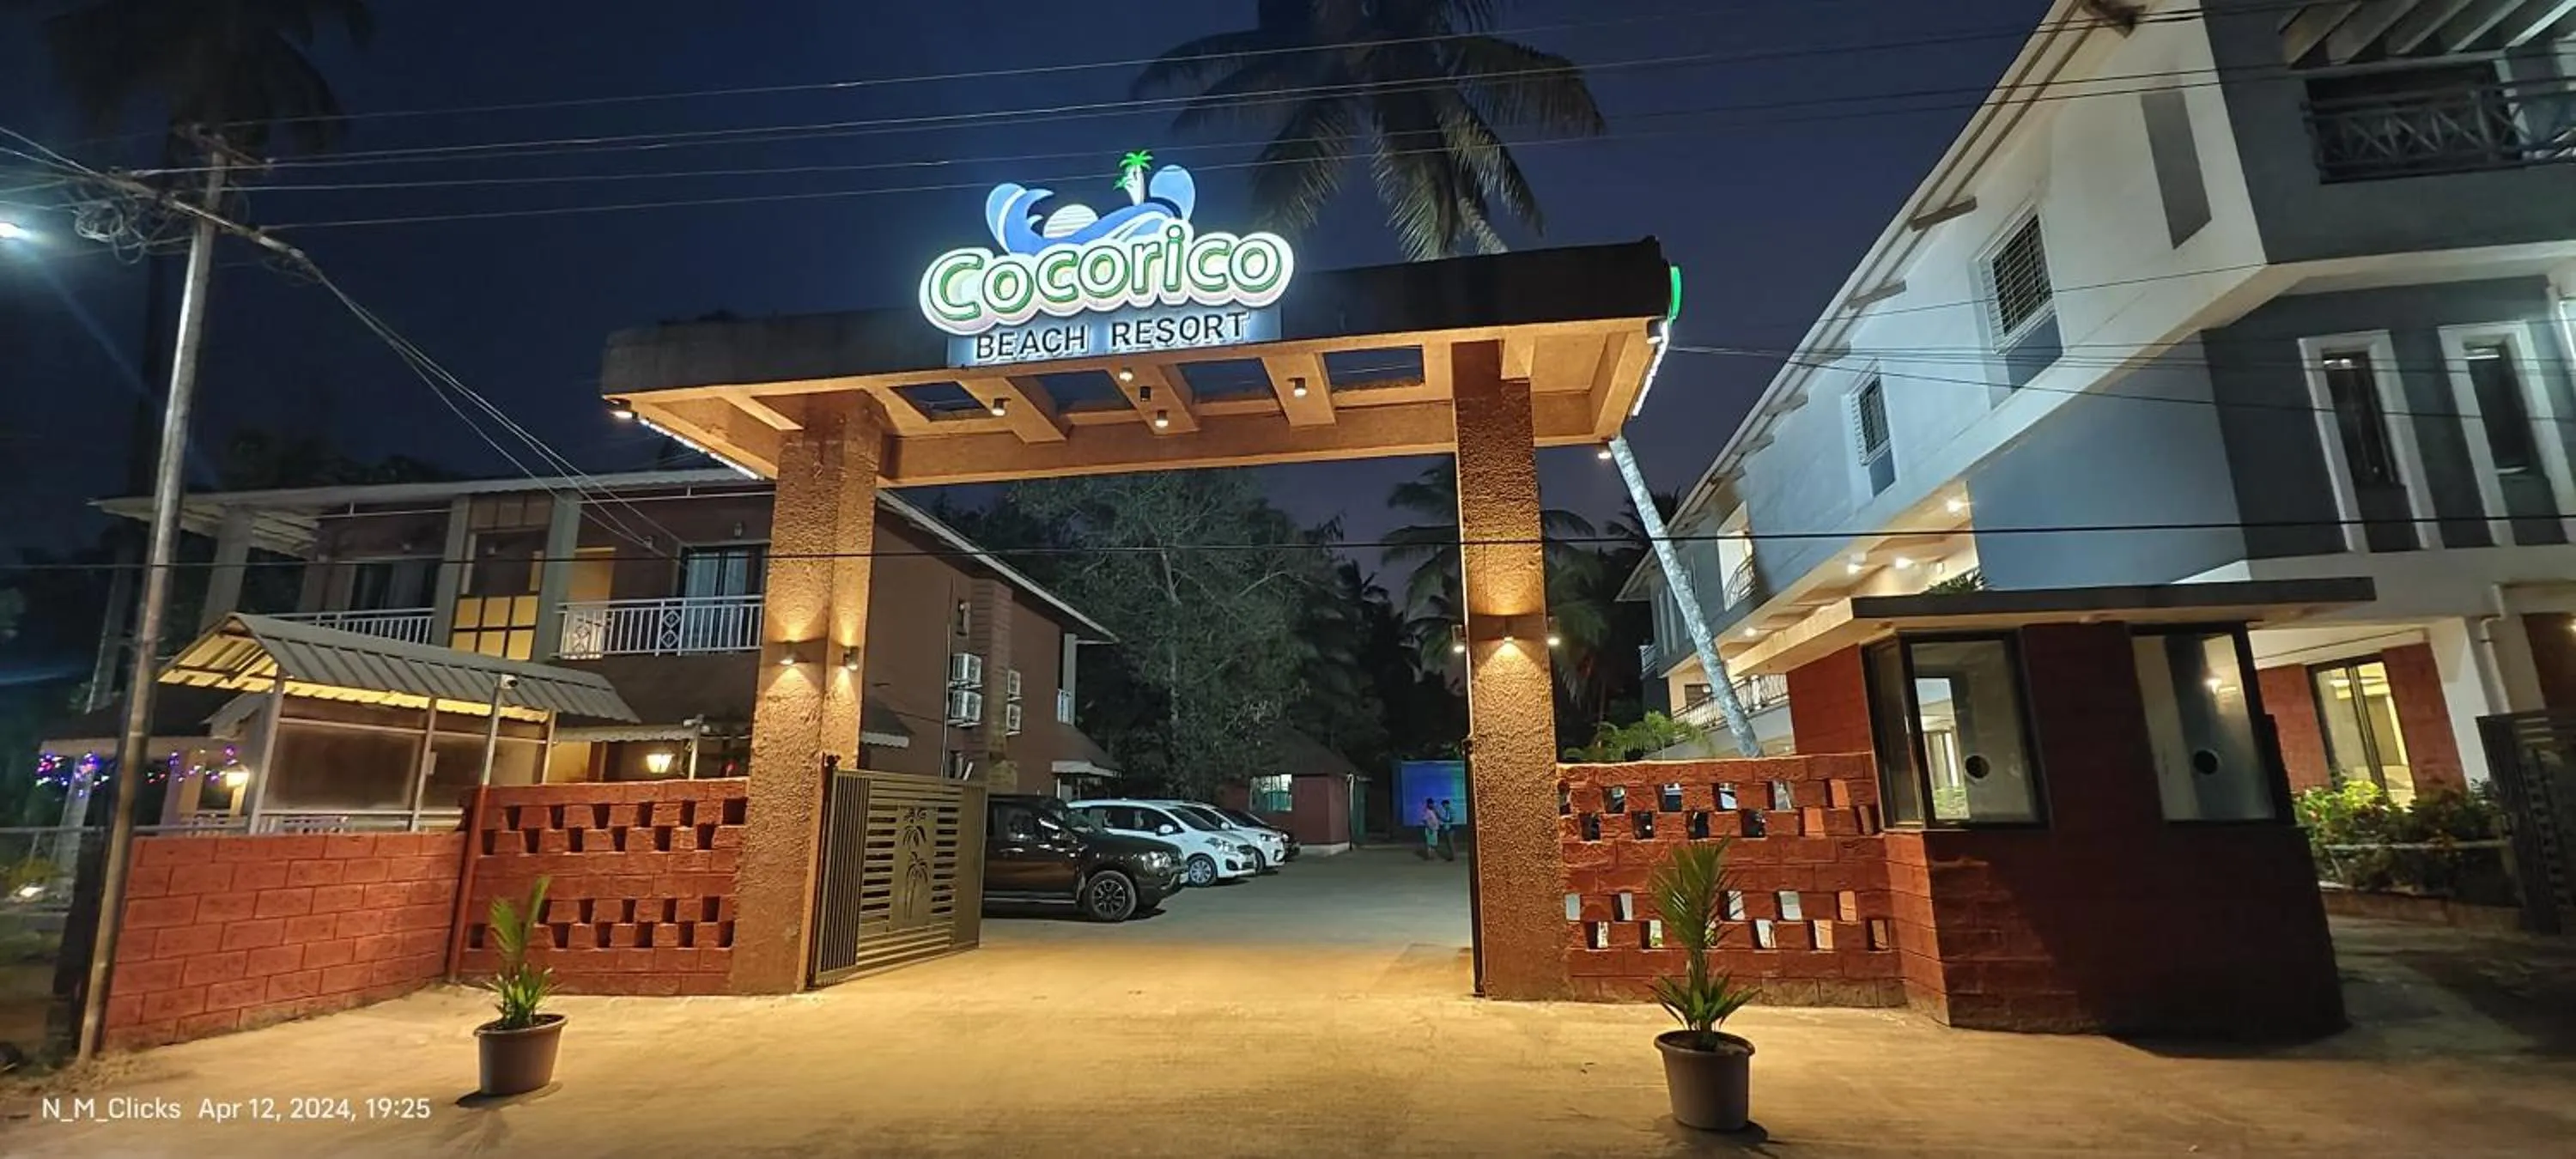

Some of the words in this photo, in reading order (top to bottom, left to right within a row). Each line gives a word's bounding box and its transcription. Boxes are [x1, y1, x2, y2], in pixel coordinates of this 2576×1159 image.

[927, 223, 1284, 323] Cocorico
[976, 325, 1089, 361] BEACH
[1111, 312, 1249, 351] RESORT
